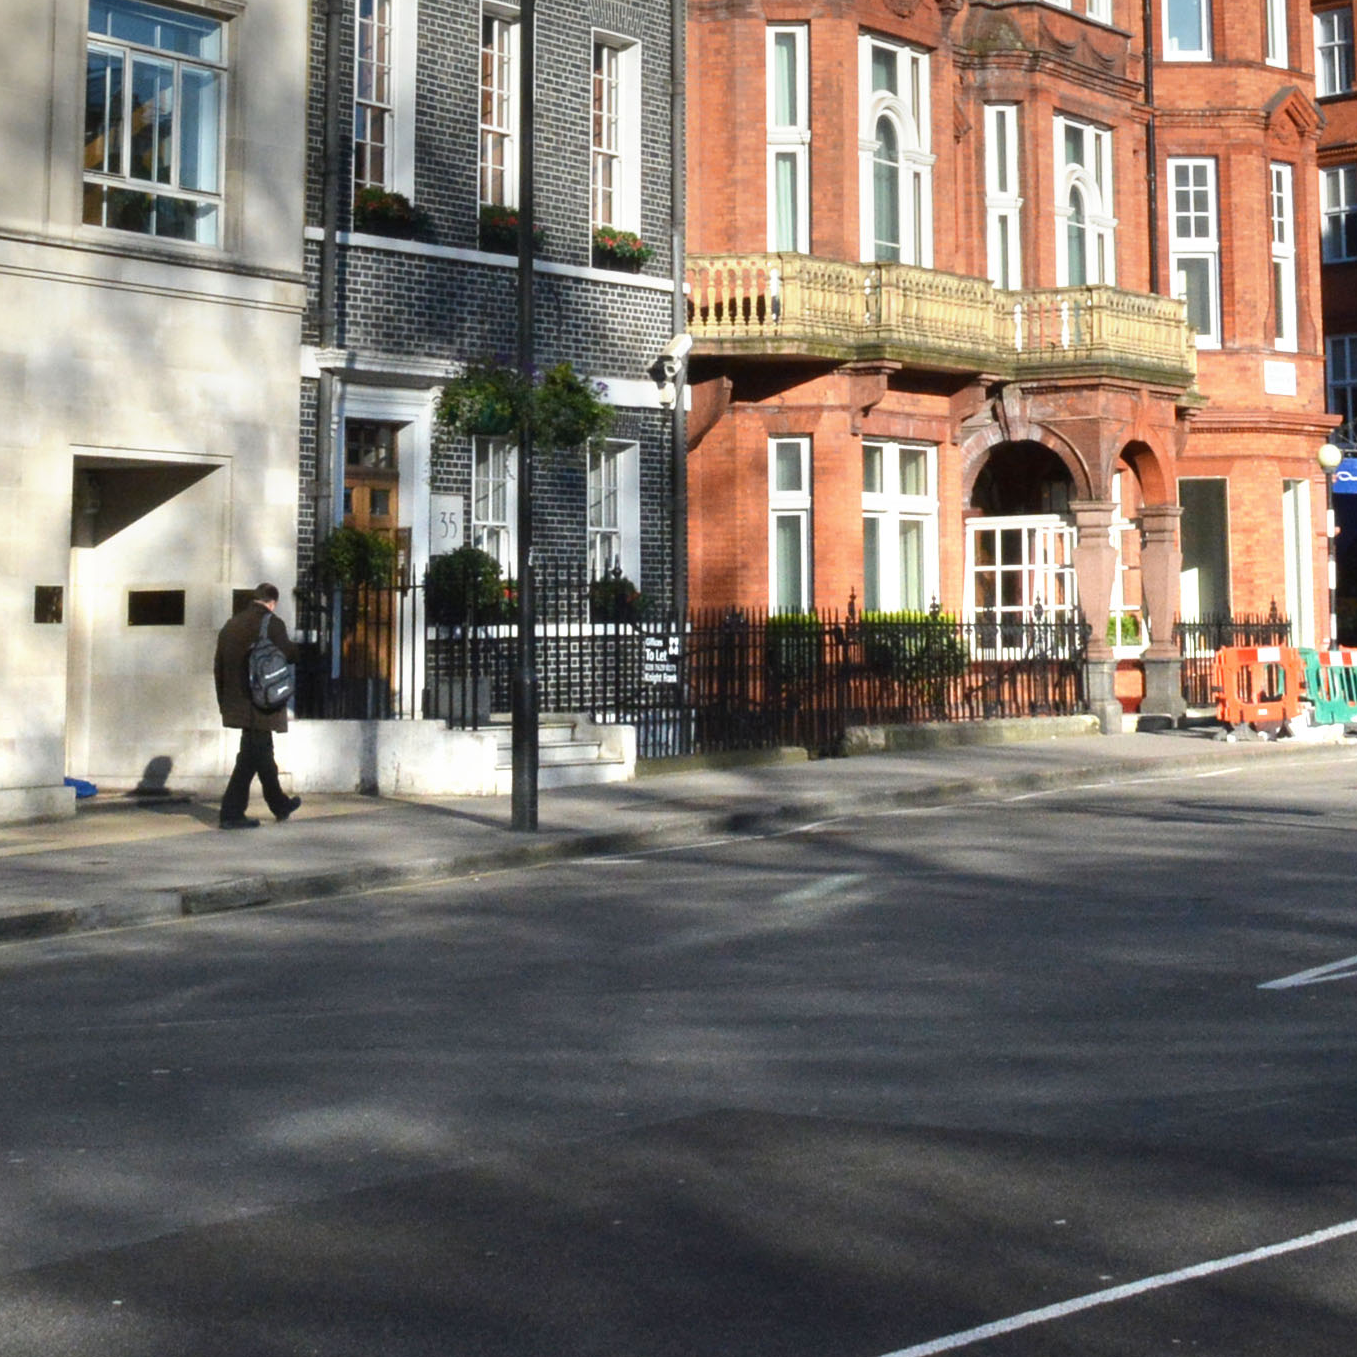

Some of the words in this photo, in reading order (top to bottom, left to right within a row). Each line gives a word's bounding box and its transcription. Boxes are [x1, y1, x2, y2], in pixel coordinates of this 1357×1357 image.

[440, 511, 458, 539] 35
[645, 648, 654, 662] To
[655, 649, 667, 662] Let
